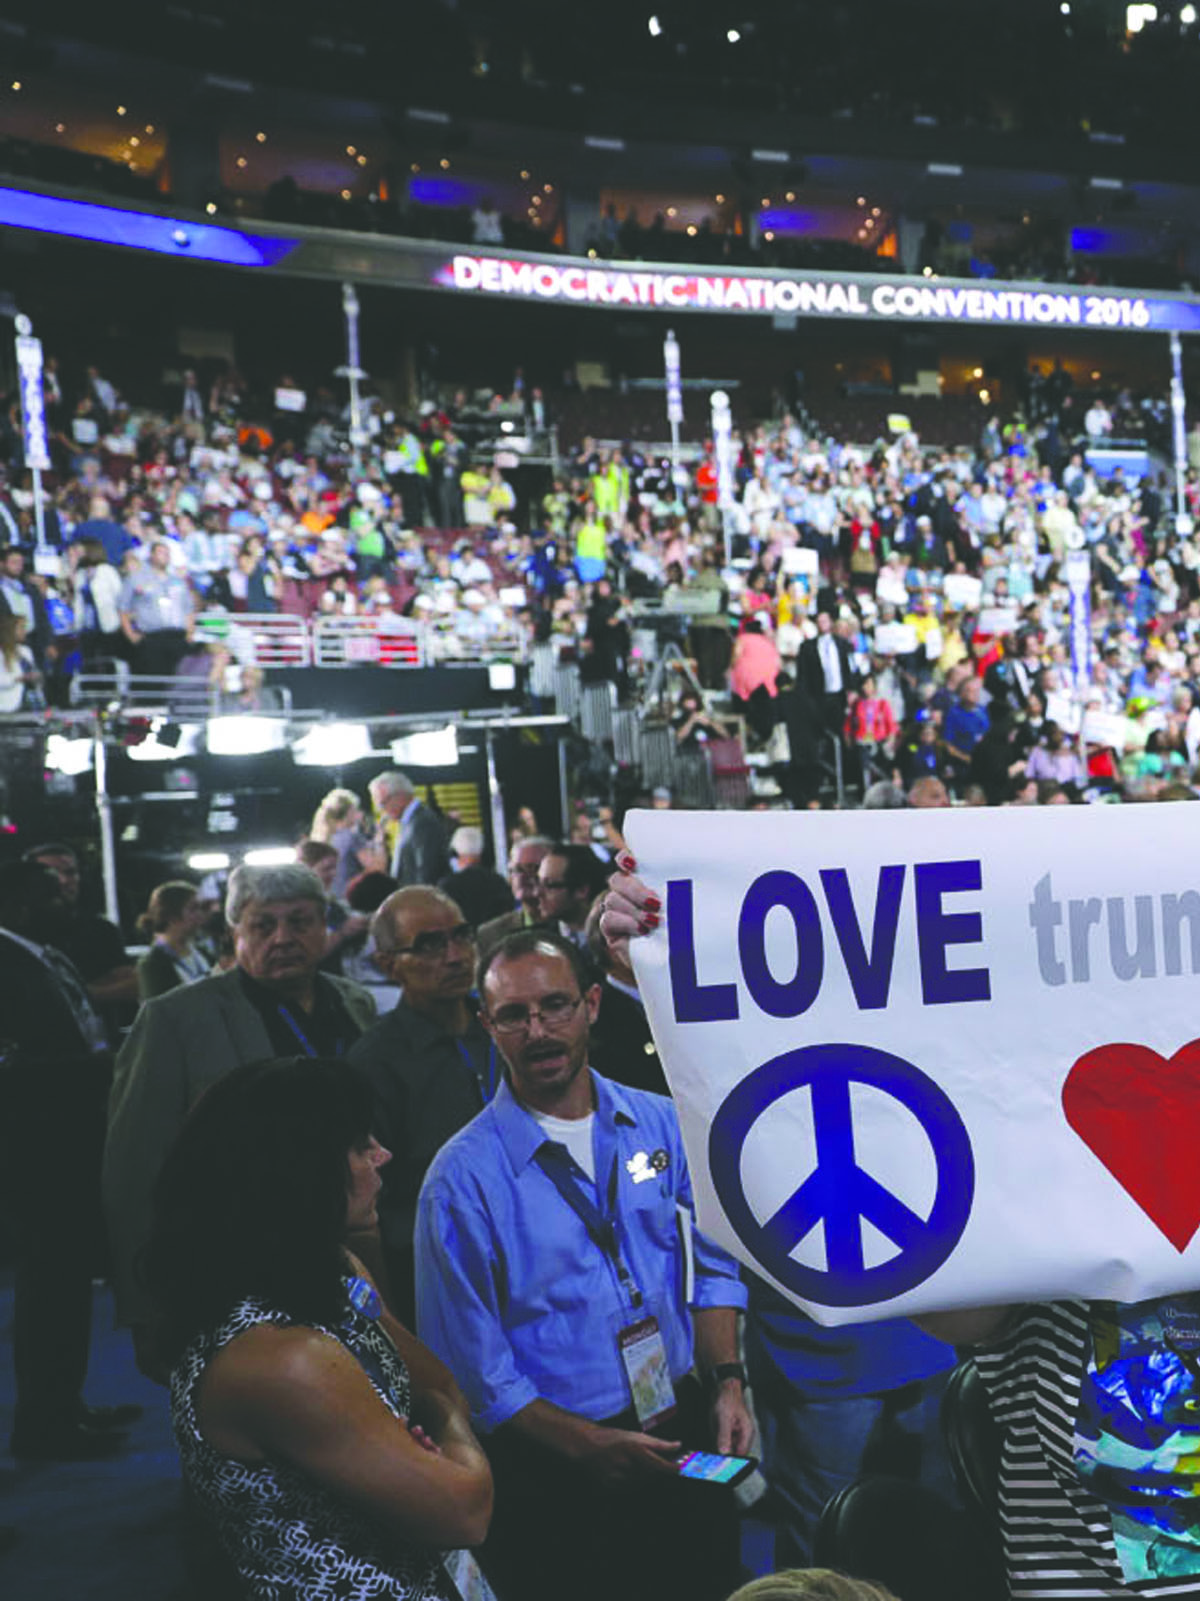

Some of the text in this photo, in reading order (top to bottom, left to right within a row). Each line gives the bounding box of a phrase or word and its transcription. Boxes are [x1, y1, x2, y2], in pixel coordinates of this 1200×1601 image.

[453, 255, 1149, 327] DEMOCRATIC NATIONAL CONVENTION 2016
[667, 859, 991, 1024] LOVE
